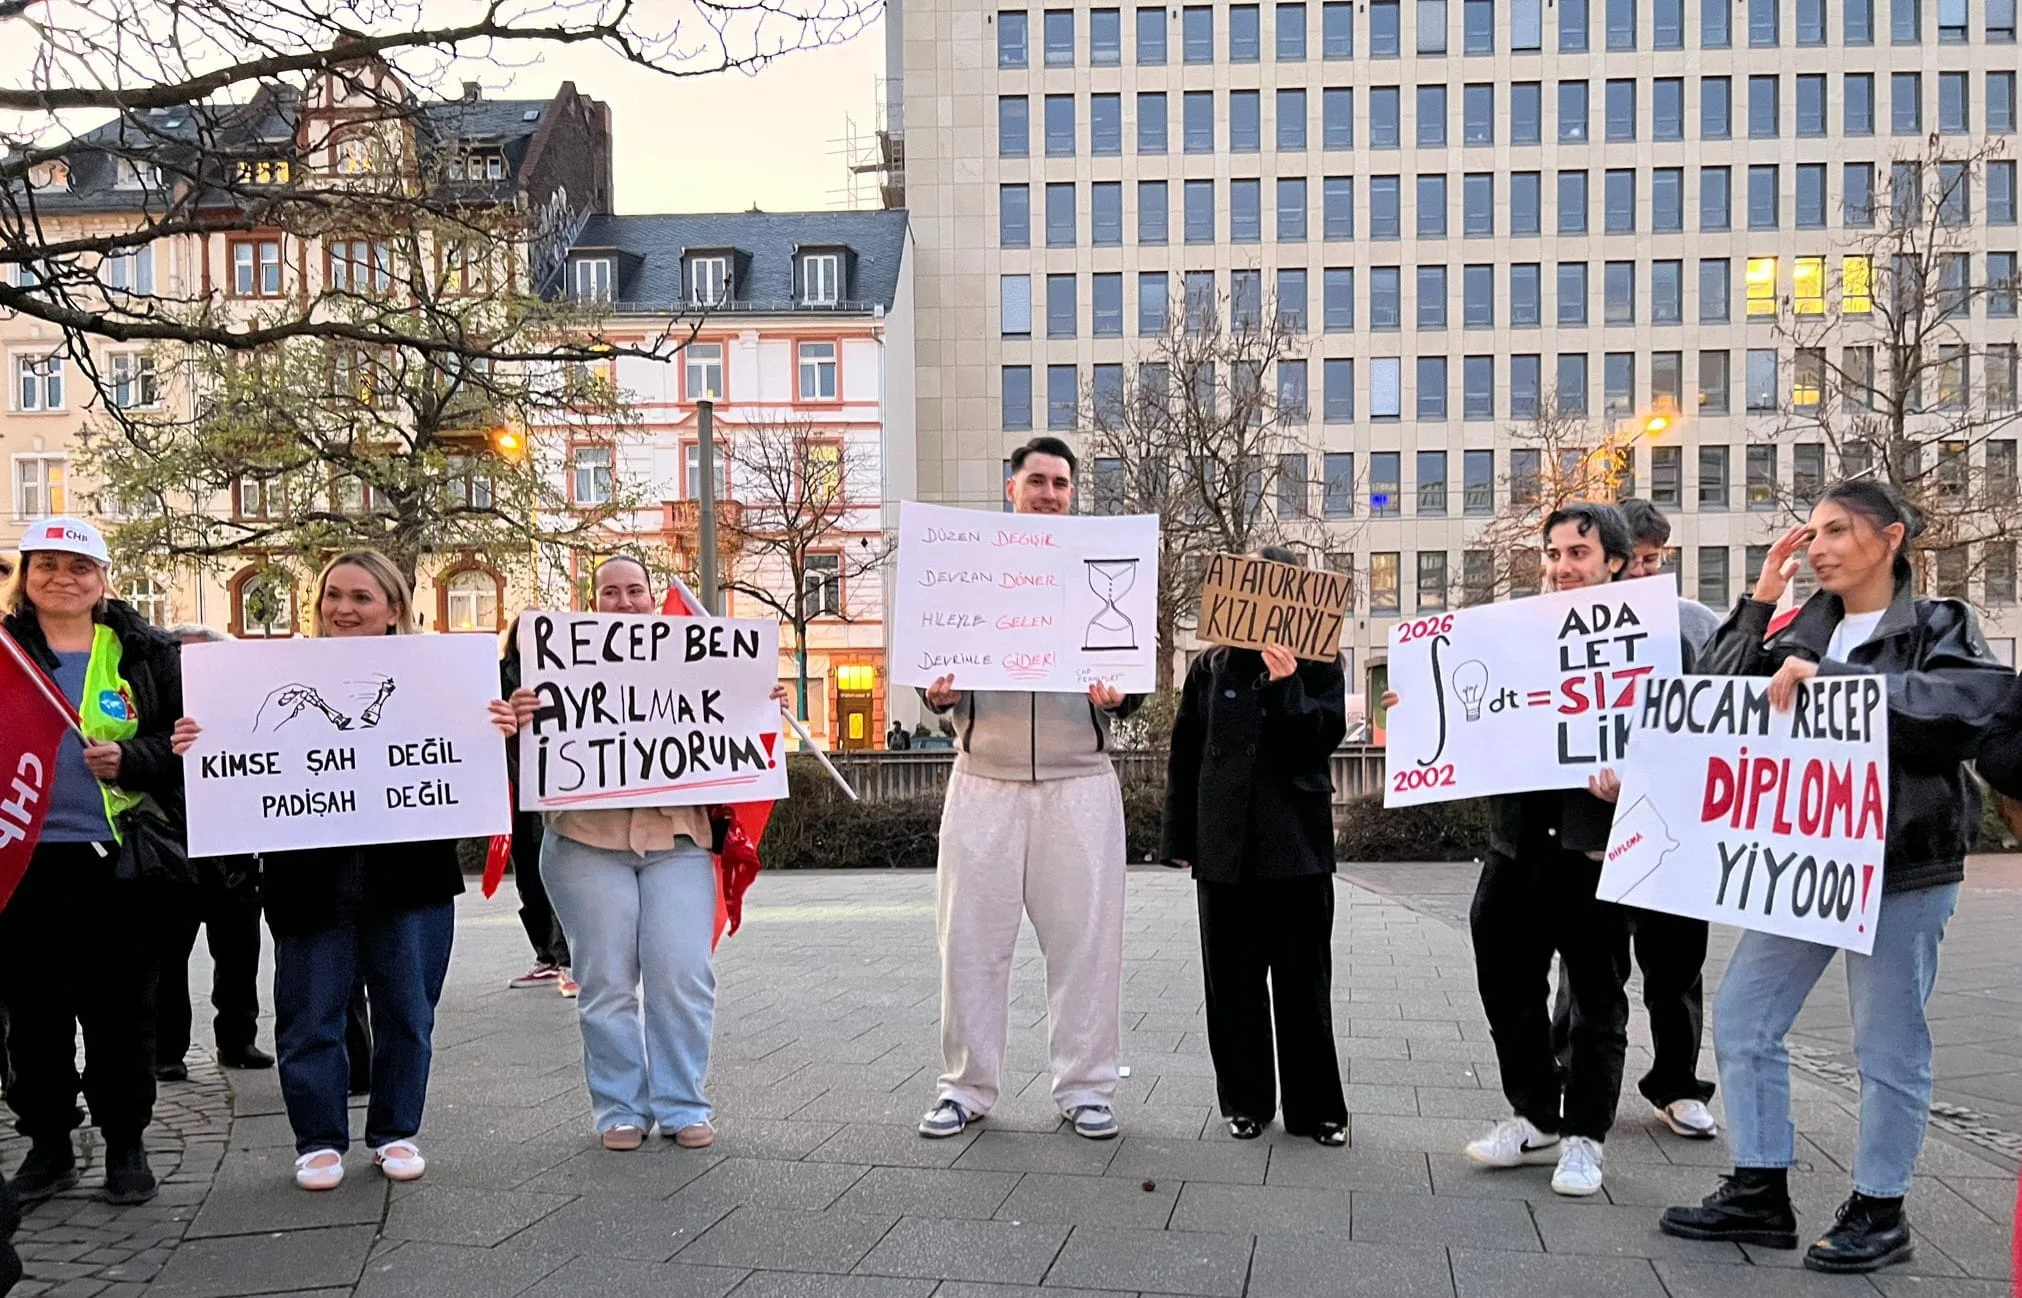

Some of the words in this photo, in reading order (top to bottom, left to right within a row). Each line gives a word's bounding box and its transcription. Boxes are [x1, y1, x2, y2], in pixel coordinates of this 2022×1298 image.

[66, 530, 88, 541] CHP
[921, 527, 980, 543] DÜZEN
[918, 570, 993, 587] DEVRAN
[998, 571, 1059, 588] DÖNER
[995, 615, 1052, 630] GELEN
[1206, 593, 1342, 657] KIZLARIYIZ
[1398, 615, 1454, 644] 2026
[1557, 602, 1641, 640] ADA
[534, 616, 670, 670] RECEP
[684, 624, 759, 663] BEN
[1559, 633, 1648, 672] LET
[532, 681, 725, 735] AYRILMAK
[1641, 678, 1771, 735] HOCAM
[1790, 679, 1881, 742] RECEP
[201, 751, 281, 778] KİMSE
[306, 748, 356, 776] ŞAH
[388, 737, 462, 767] DEĞİL
[538, 730, 778, 797] İSTİYORUM!
[1393, 764, 1456, 792] 2002
[1701, 746, 1885, 841] DİPLOMA
[262, 788, 356, 817] PADİŞAH
[386, 779, 459, 809] DEĞİL
